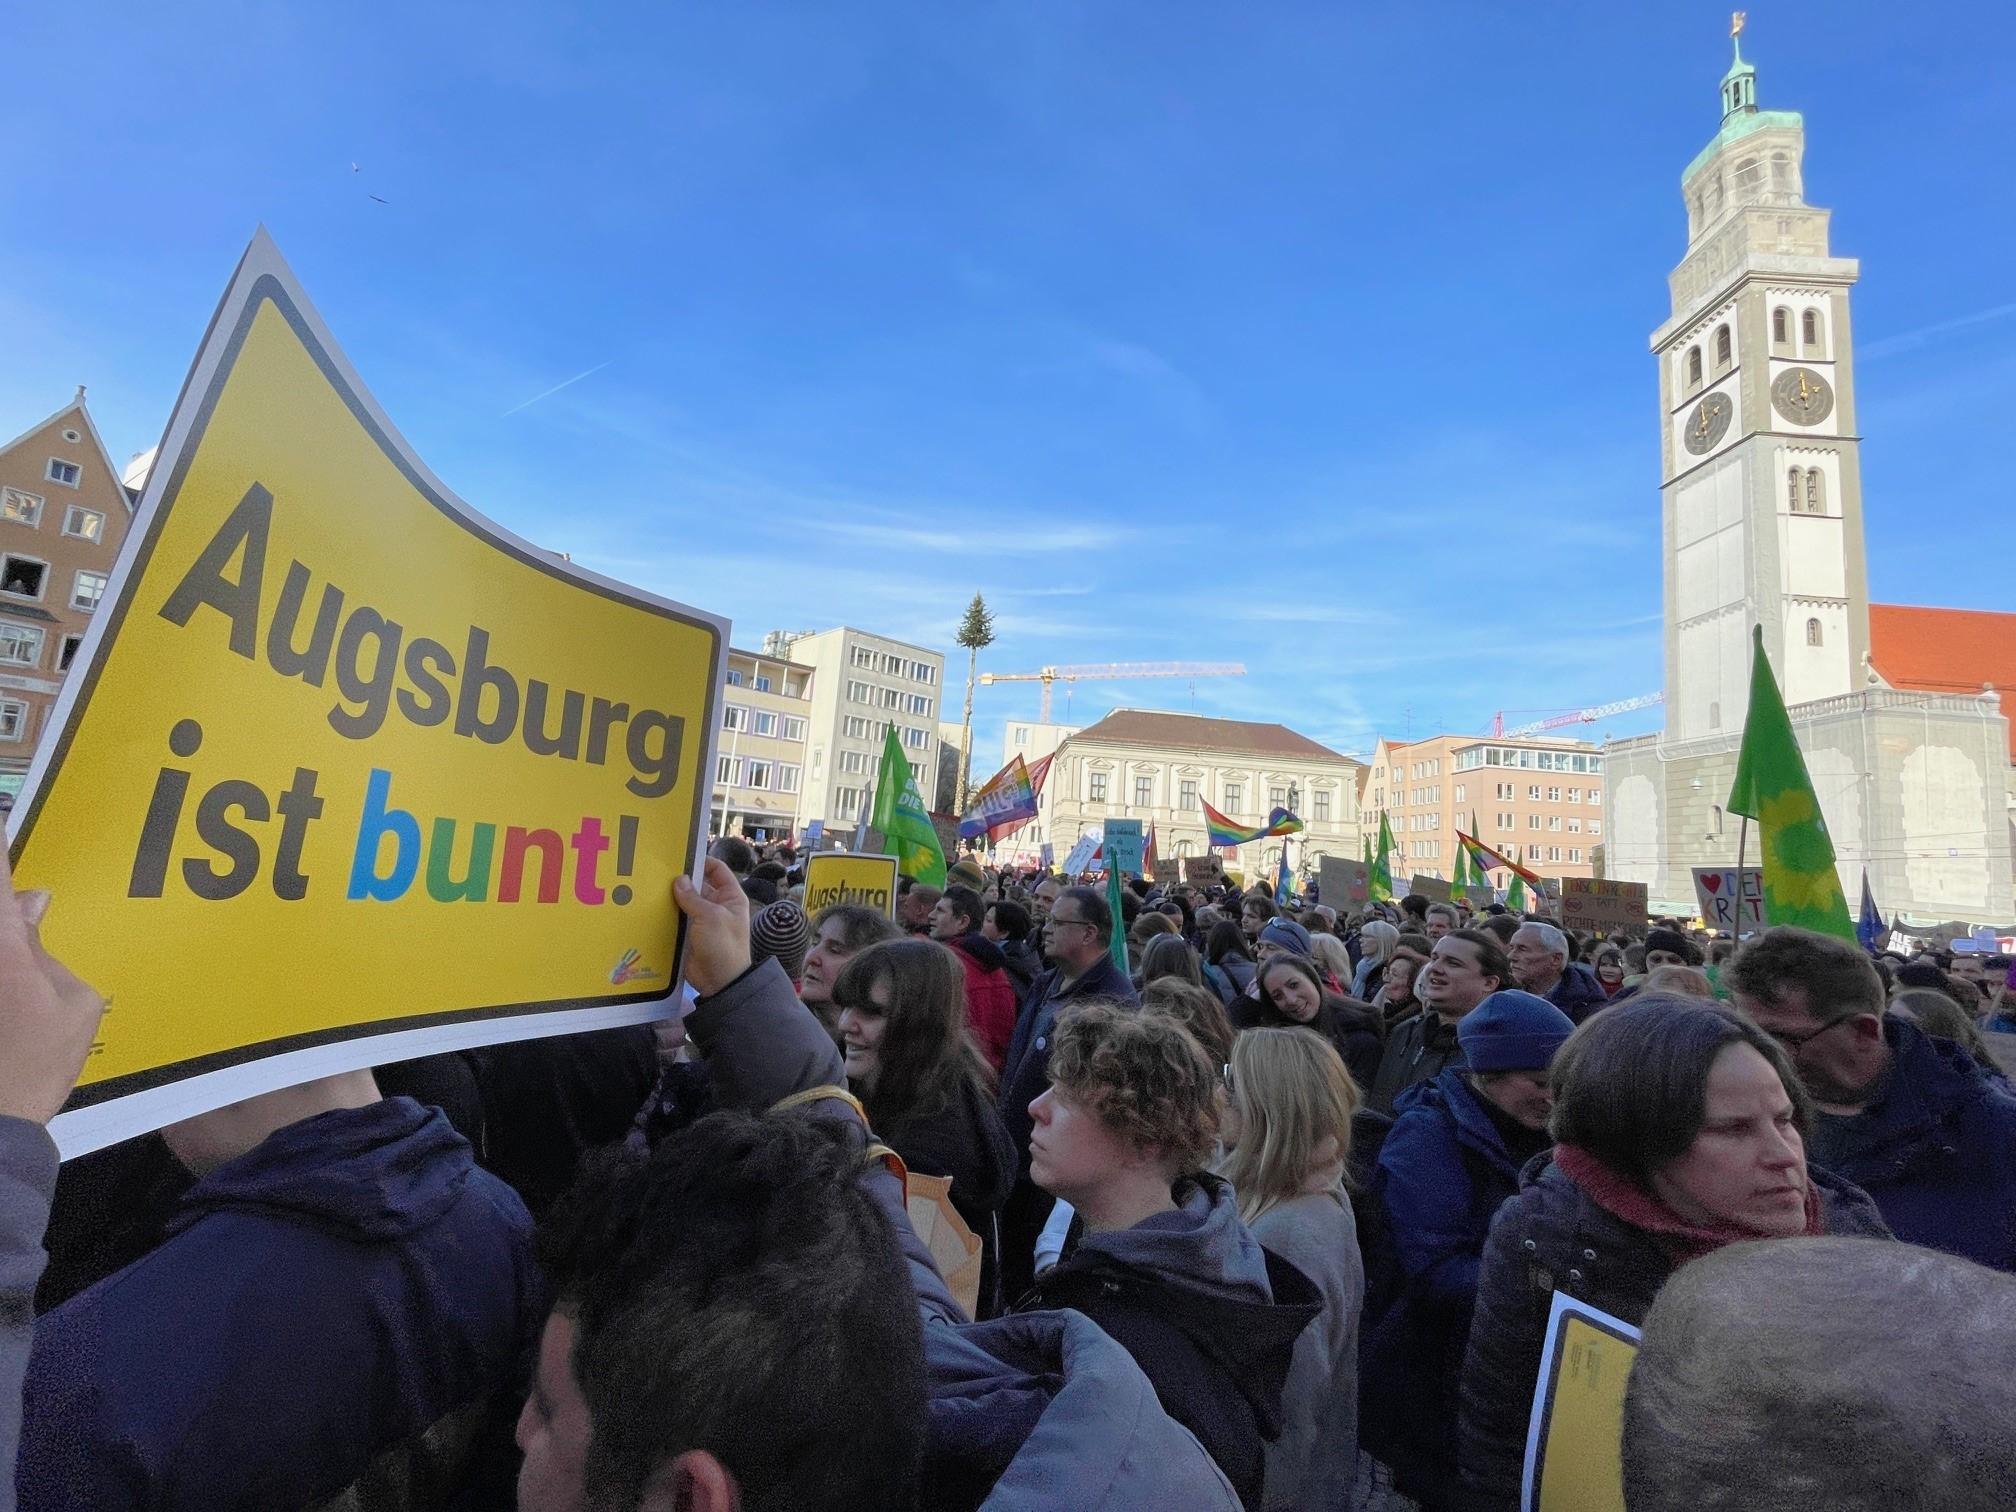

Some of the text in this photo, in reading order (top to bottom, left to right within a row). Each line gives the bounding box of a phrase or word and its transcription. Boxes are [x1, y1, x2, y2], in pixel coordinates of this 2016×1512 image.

[159, 481, 686, 798] Augsburg
[127, 719, 640, 906] ist bunt!
